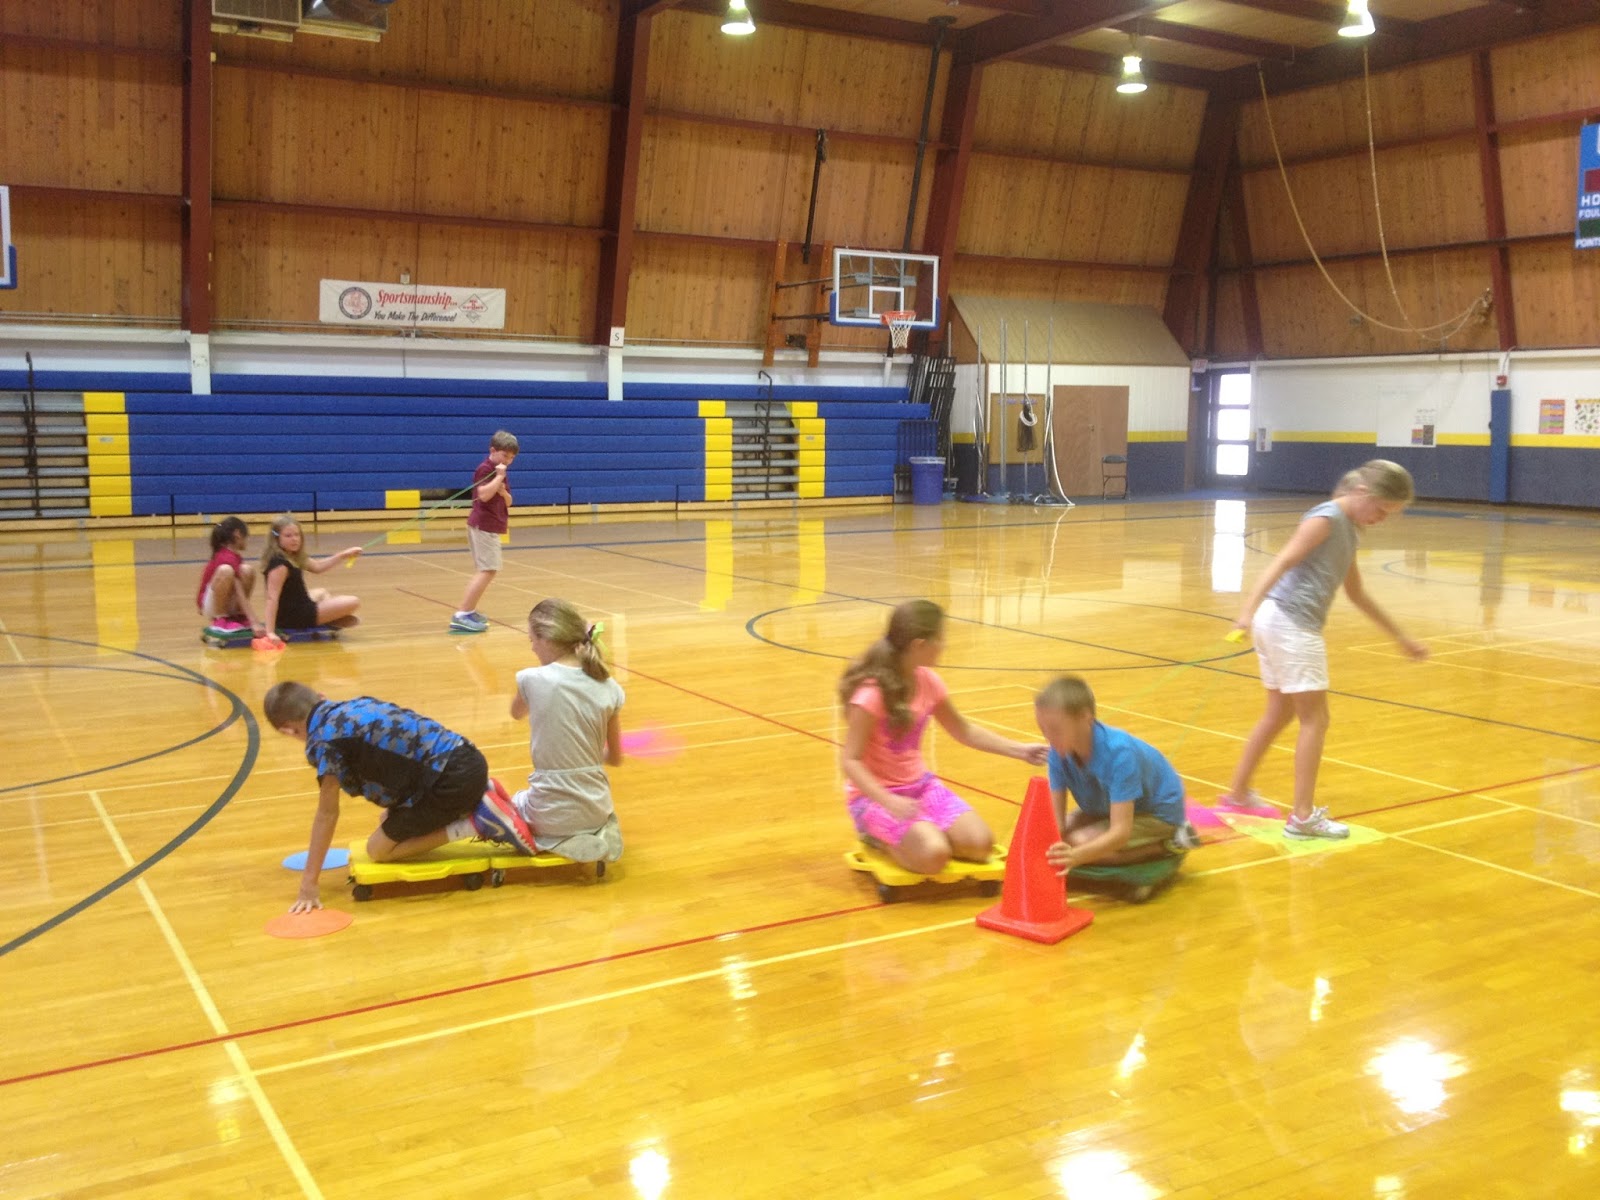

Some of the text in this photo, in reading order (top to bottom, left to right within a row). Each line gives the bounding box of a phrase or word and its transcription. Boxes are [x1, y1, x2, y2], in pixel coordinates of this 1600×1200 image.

[374, 310, 457, 322] You Make The Difference!
[614, 332, 620, 341] S
